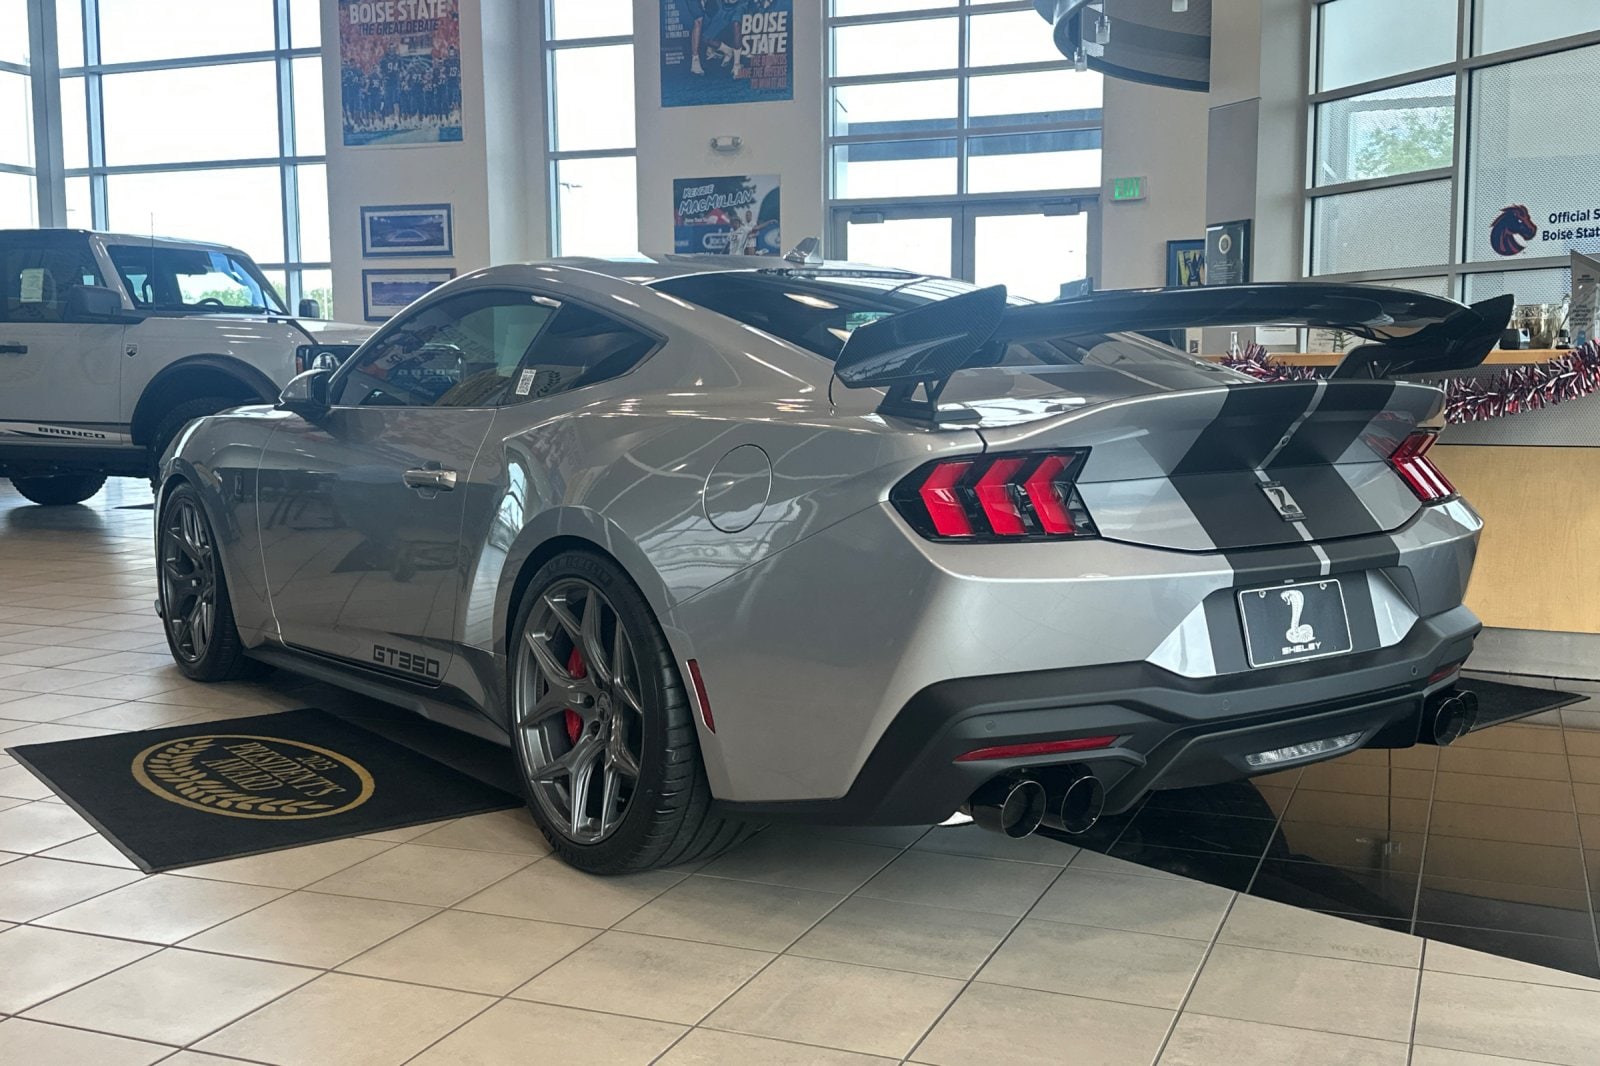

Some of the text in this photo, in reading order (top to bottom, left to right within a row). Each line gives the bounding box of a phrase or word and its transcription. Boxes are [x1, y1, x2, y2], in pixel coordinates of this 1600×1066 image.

[349, 0, 447, 25] BOISE STATE
[741, 11, 788, 35] BOISE
[359, 19, 439, 36] THE GREAT DEBATE
[741, 32, 788, 55] STATE
[682, 183, 715, 199] KENZIE
[1114, 177, 1139, 199] EXIT
[1549, 209, 1590, 224] Official
[1542, 229, 1574, 241] Boise
[37, 426, 106, 439] BRONCO
[1281, 641, 1322, 655] SHELBY
[373, 644, 440, 678] GT350
[200, 758, 284, 791] AWARD
[222, 742, 347, 797] PRESIDENT'S
